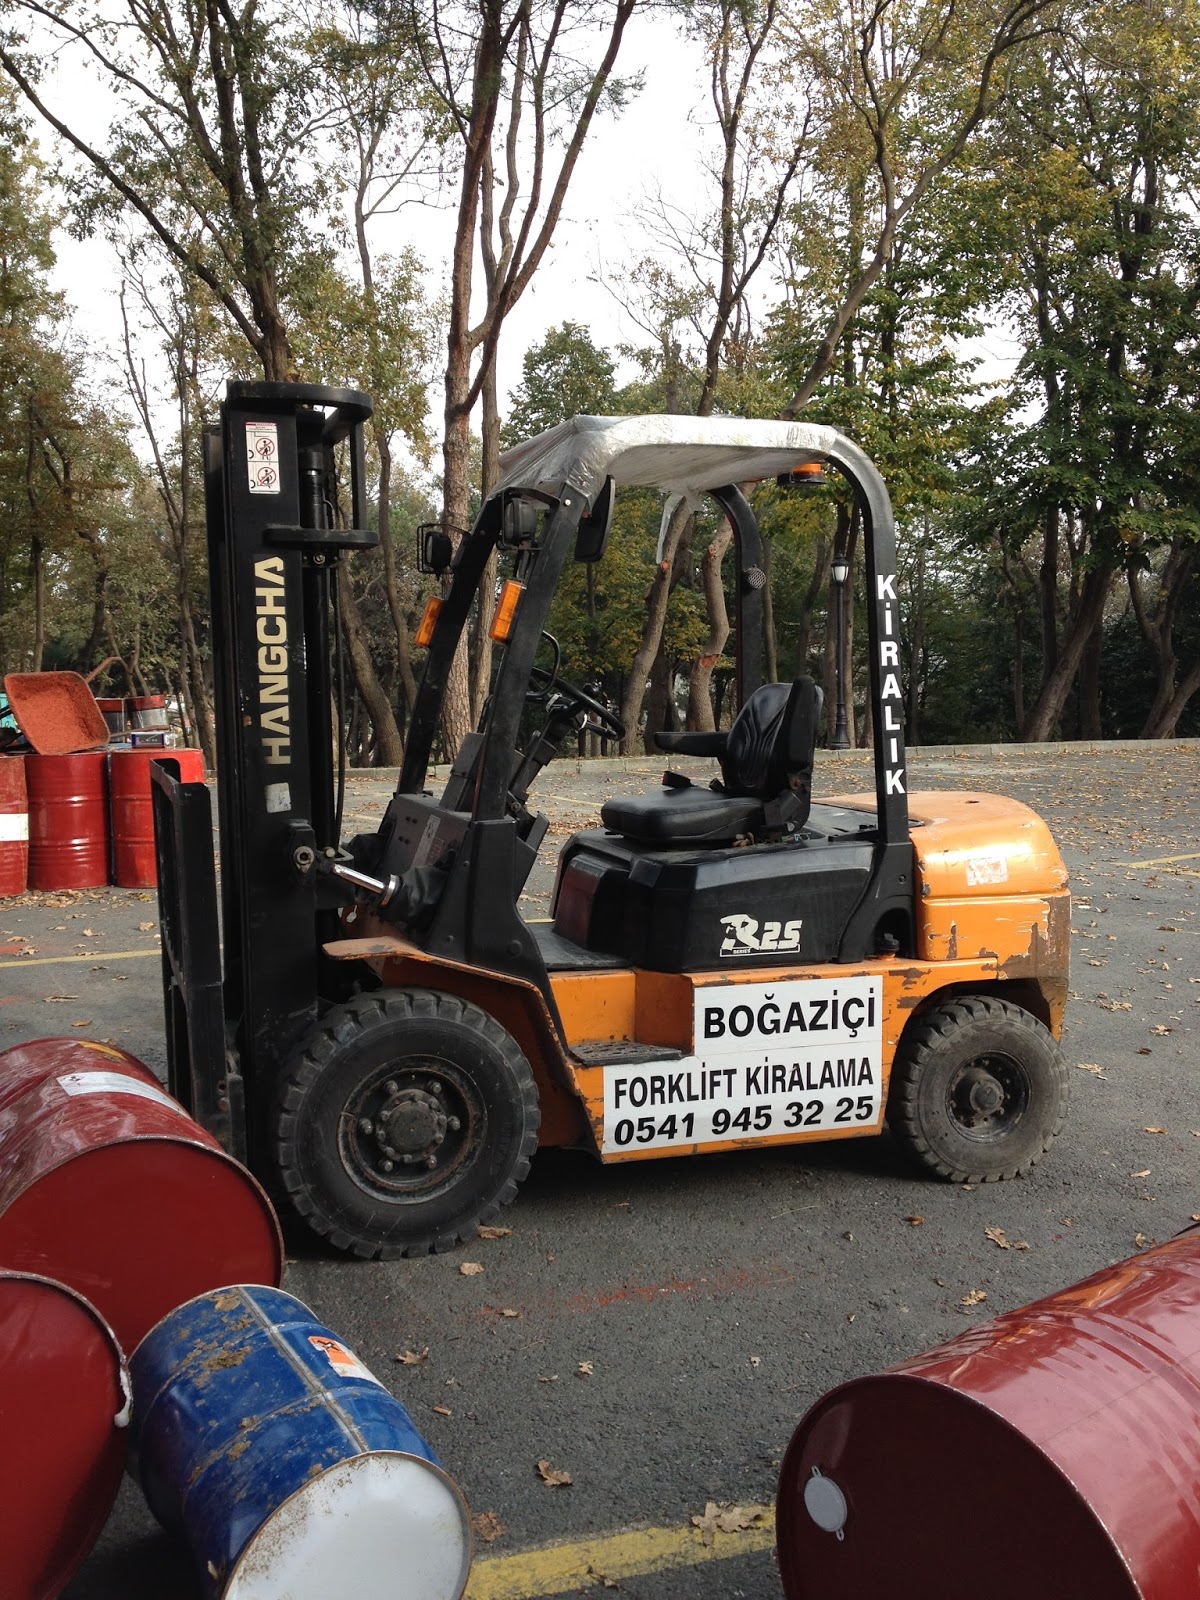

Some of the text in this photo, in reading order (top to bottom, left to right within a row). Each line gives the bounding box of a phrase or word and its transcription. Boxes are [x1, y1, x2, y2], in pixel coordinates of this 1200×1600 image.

[254, 556, 291, 765] HANGCHA
[877, 574, 905, 794] KİRALIK
[704, 987, 875, 1038] BOĞAZİÇİ
[614, 1057, 873, 1109] FORKLİFT KİRALAMA
[614, 1096, 874, 1145] 0541 945 32 25
